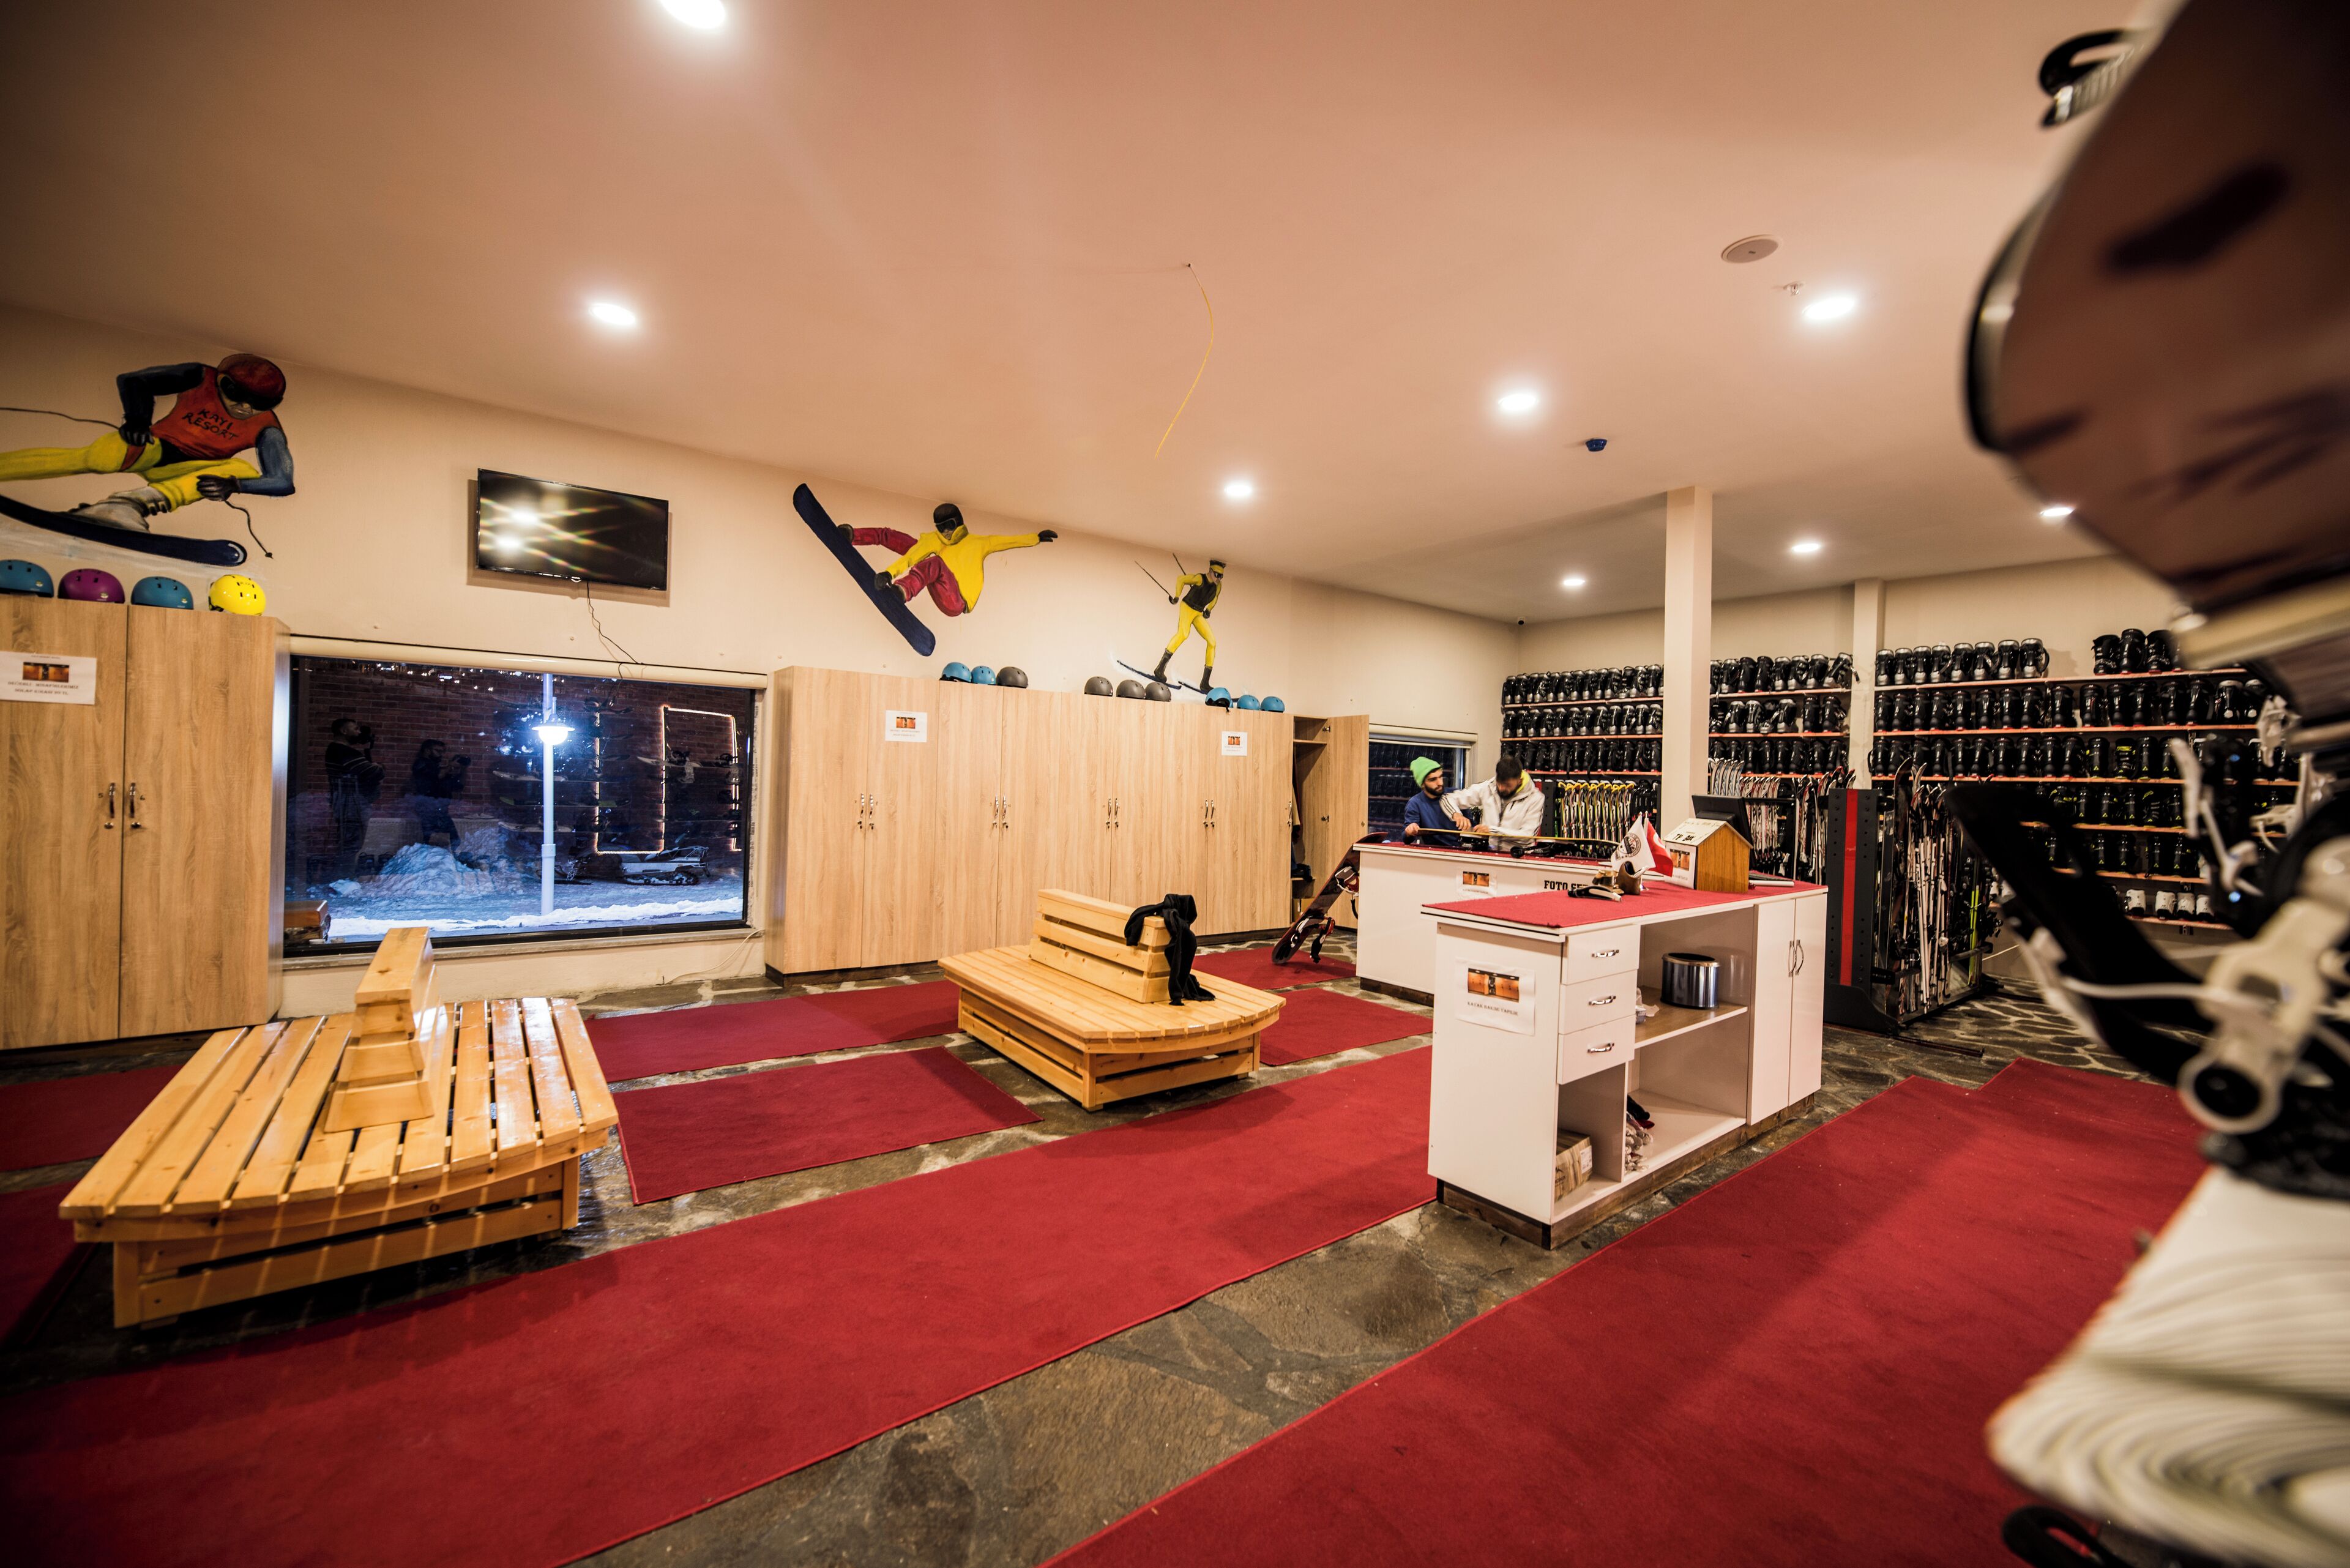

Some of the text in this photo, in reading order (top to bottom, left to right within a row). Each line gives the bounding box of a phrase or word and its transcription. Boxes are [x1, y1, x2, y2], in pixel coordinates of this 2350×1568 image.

[182, 412, 239, 440] RESORT
[198, 408, 233, 430] KAYI
[1543, 879, 1568, 890] FOTO
